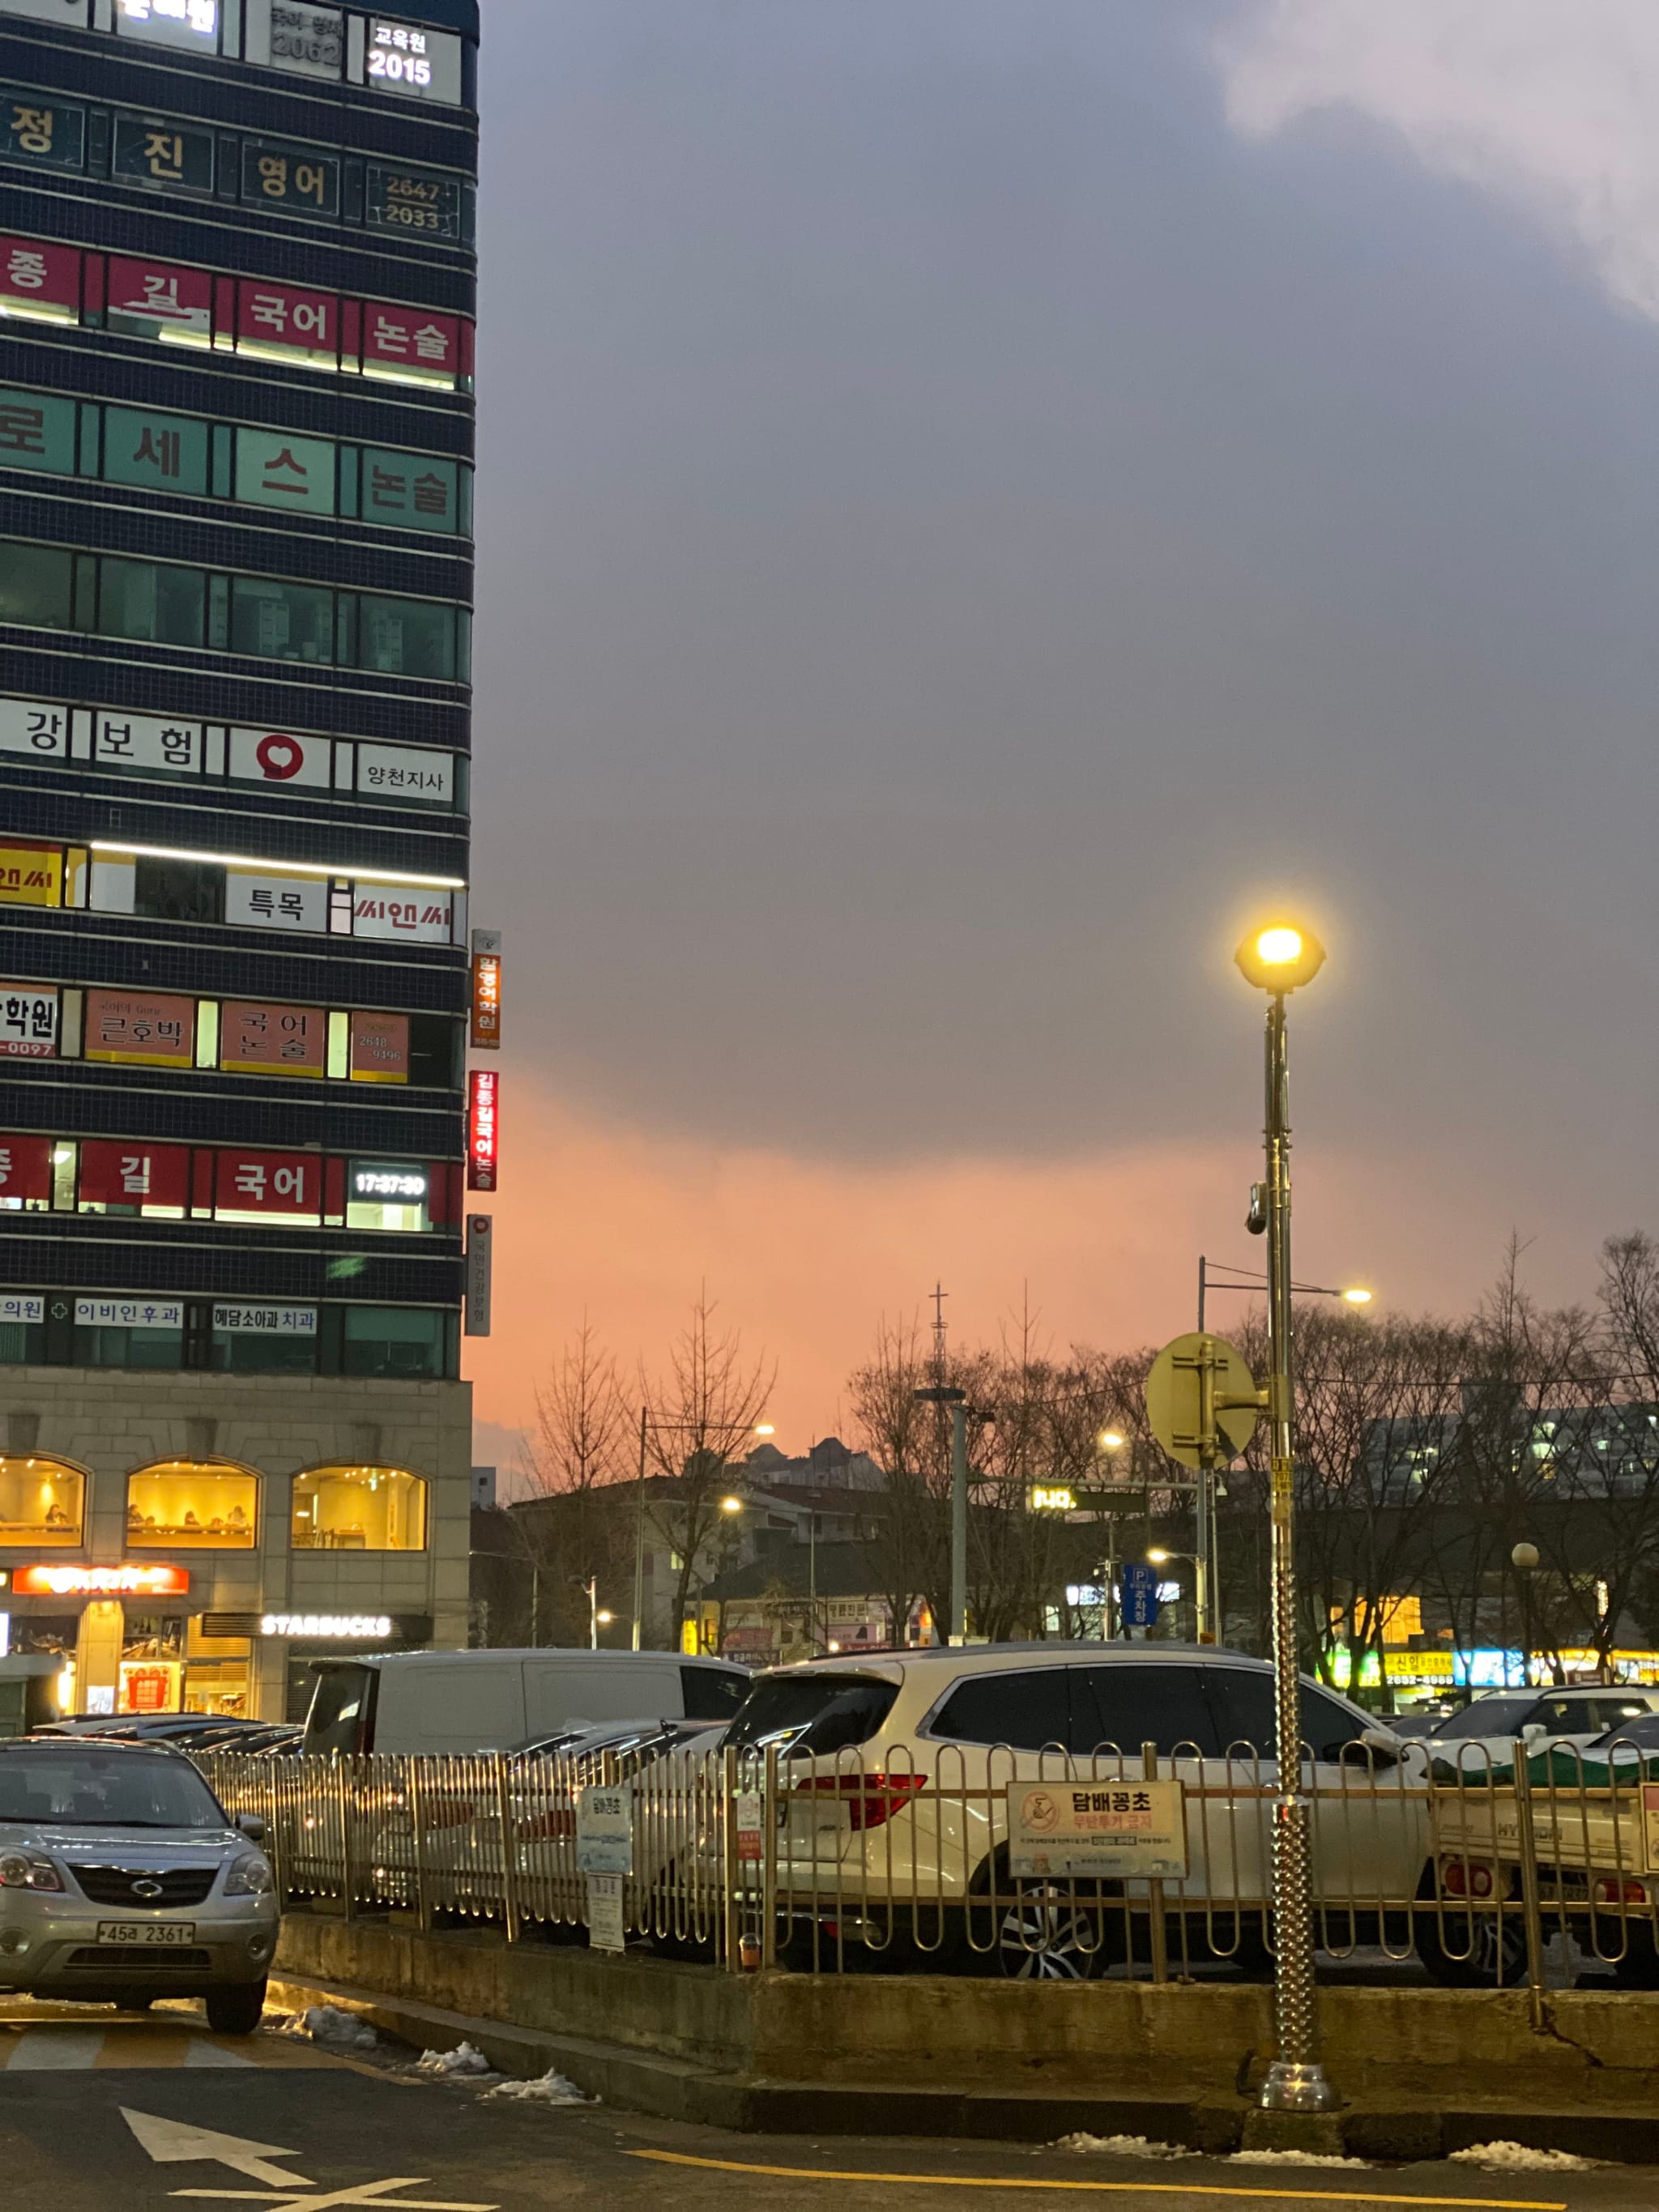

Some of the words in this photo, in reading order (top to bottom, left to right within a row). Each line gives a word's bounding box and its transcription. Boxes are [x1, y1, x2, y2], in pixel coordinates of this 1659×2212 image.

[375, 27, 425, 53] 교육원
[271, 34, 340, 66] 2062
[369, 50, 431, 85] 2015
[11, 106, 53, 153] 정
[144, 132, 184, 180] 진
[258, 155, 325, 205] 영어
[386, 177, 439, 200] 2647
[386, 205, 439, 229] 2033
[7, 249, 47, 289] 종
[142, 275, 179, 309] 길
[251, 294, 326, 339] 국어
[373, 316, 449, 360] 논술
[133, 427, 180, 477] 세
[262, 447, 309, 494] 스
[371, 464, 447, 515] 논술
[27, 712, 62, 750] 강
[368, 765, 444, 792] 양천지사
[249, 889, 304, 921] 특목
[0, 997, 53, 1038] 학원
[240, 1012, 306, 1037] 국어
[100, 1016, 183, 1048] 큰호박
[360, 1036, 387, 1047] 2648
[240, 1035, 306, 1059] 논술
[120, 1156, 151, 1194] 길
[234, 1165, 304, 1203] 국어
[5, 1301, 41, 1319] 의원
[78, 1303, 180, 1324] 이비인후과
[283, 1311, 315, 1331] 치과
[1135, 1590, 1148, 1623] 주차장
[261, 1615, 391, 1637] STARBUCKS
[1072, 1792, 1151, 1813] 담배꽁초
[1073, 1813, 1125, 1831] 무단투기
[1127, 1813, 1152, 1831] 금지
[146, 1927, 183, 1941] 2361
